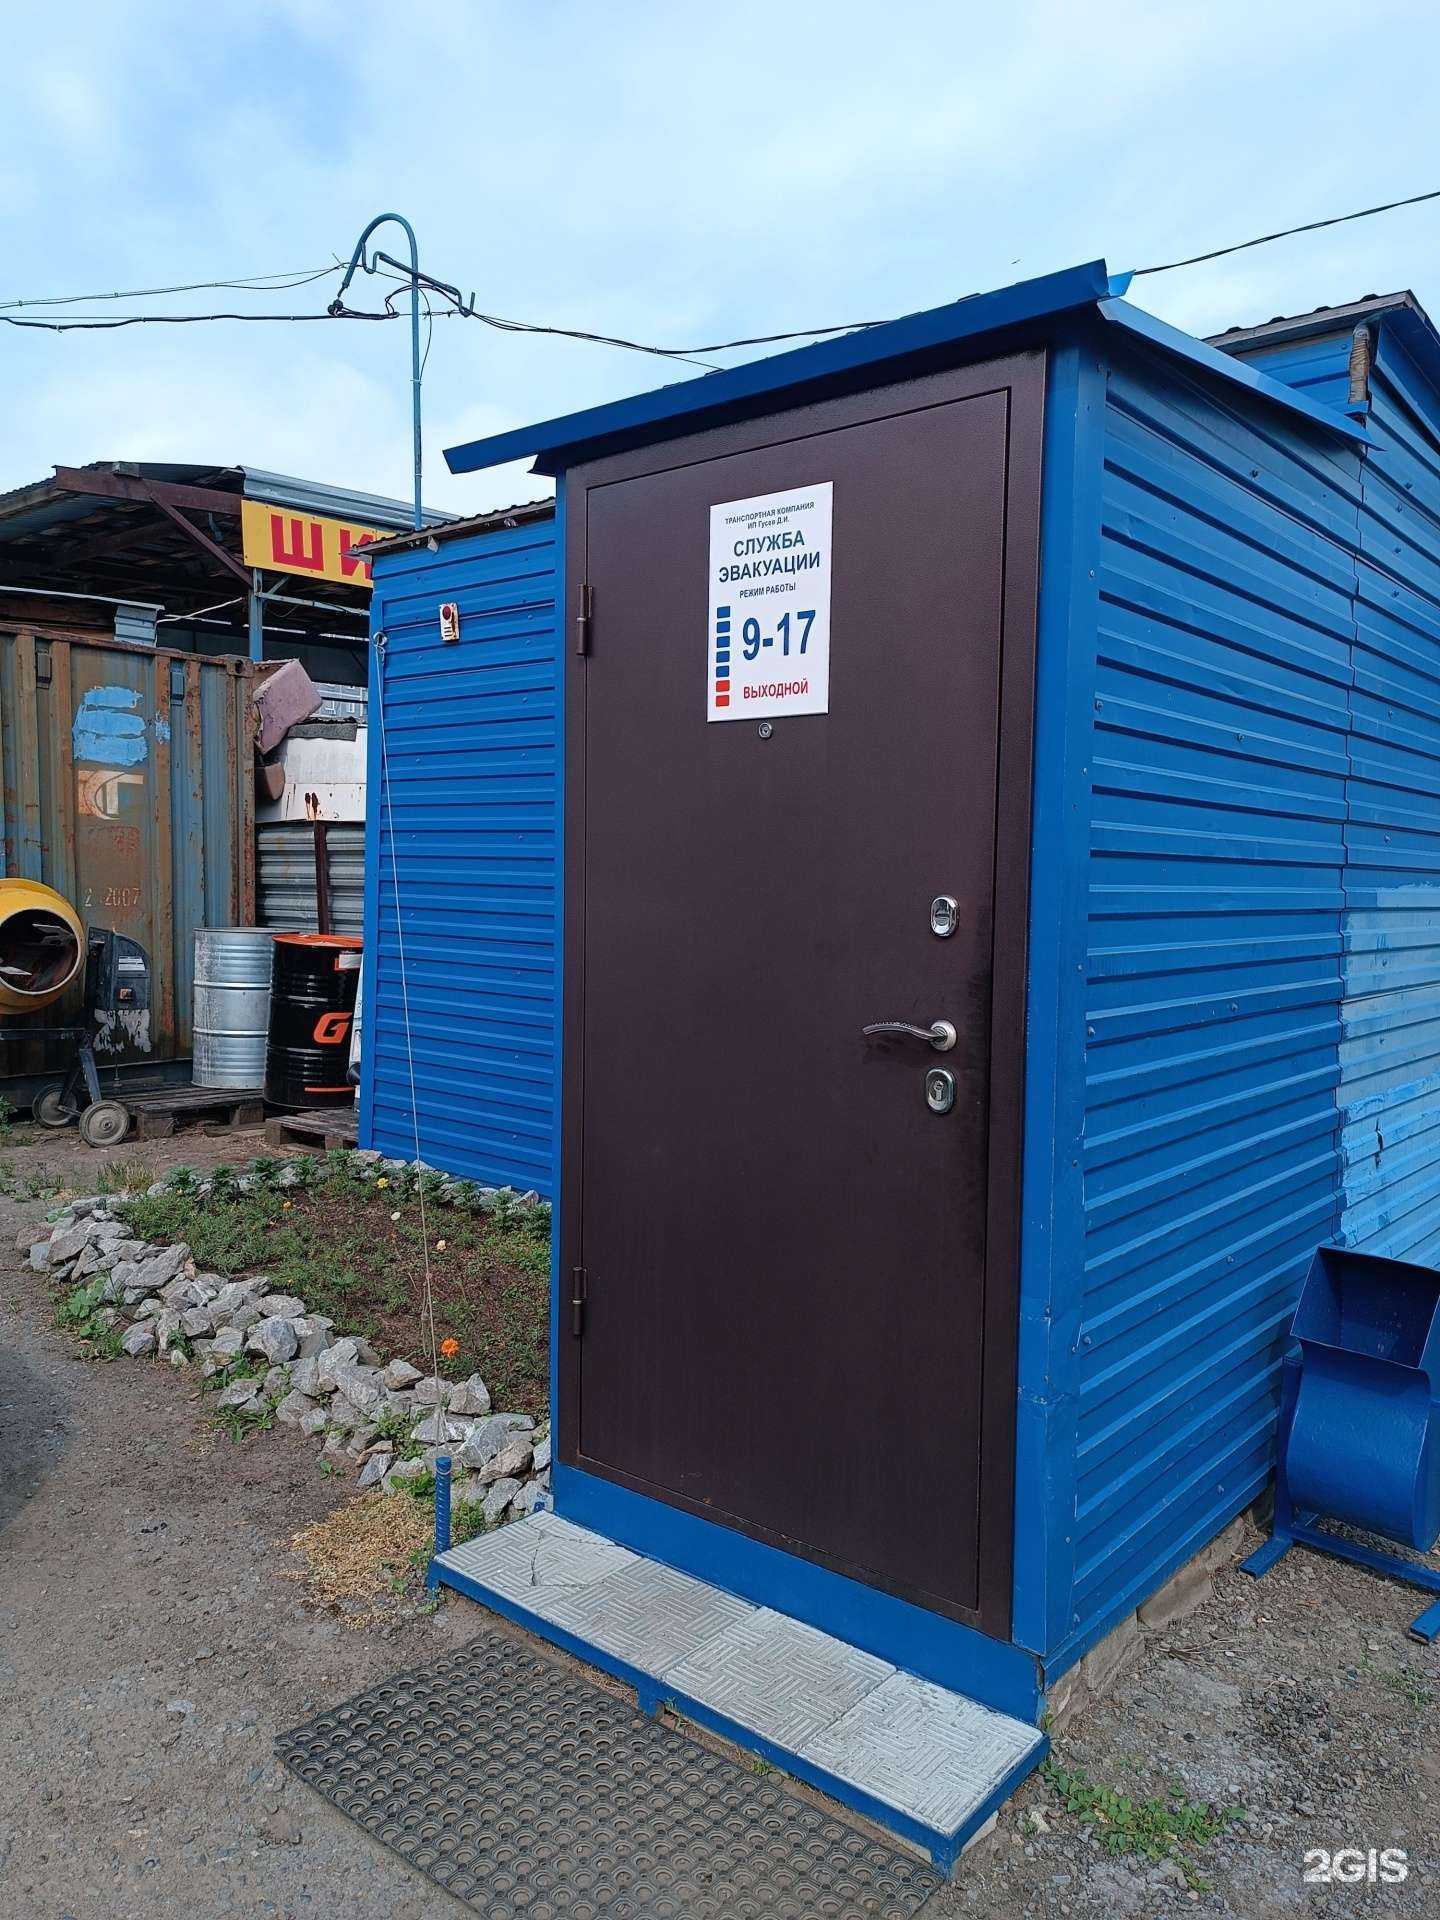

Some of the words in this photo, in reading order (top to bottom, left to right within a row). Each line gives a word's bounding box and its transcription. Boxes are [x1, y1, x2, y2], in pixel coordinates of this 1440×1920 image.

[725, 509, 776, 525] ТРАНСПОРТНАЯ
[776, 501, 815, 515] КОМПАНИЯ
[747, 521, 757, 530] ИП
[733, 530, 805, 557] СЛУЖБА
[718, 551, 820, 583] ЭВАКУАЦИИ
[739, 585, 765, 599] РЕЖИМ
[765, 582, 796, 596] РАБОТЫ
[742, 609, 816, 661] 9-17
[743, 678, 809, 700] ВЫХОДНОЙ
[313, 1012, 353, 1044] G
